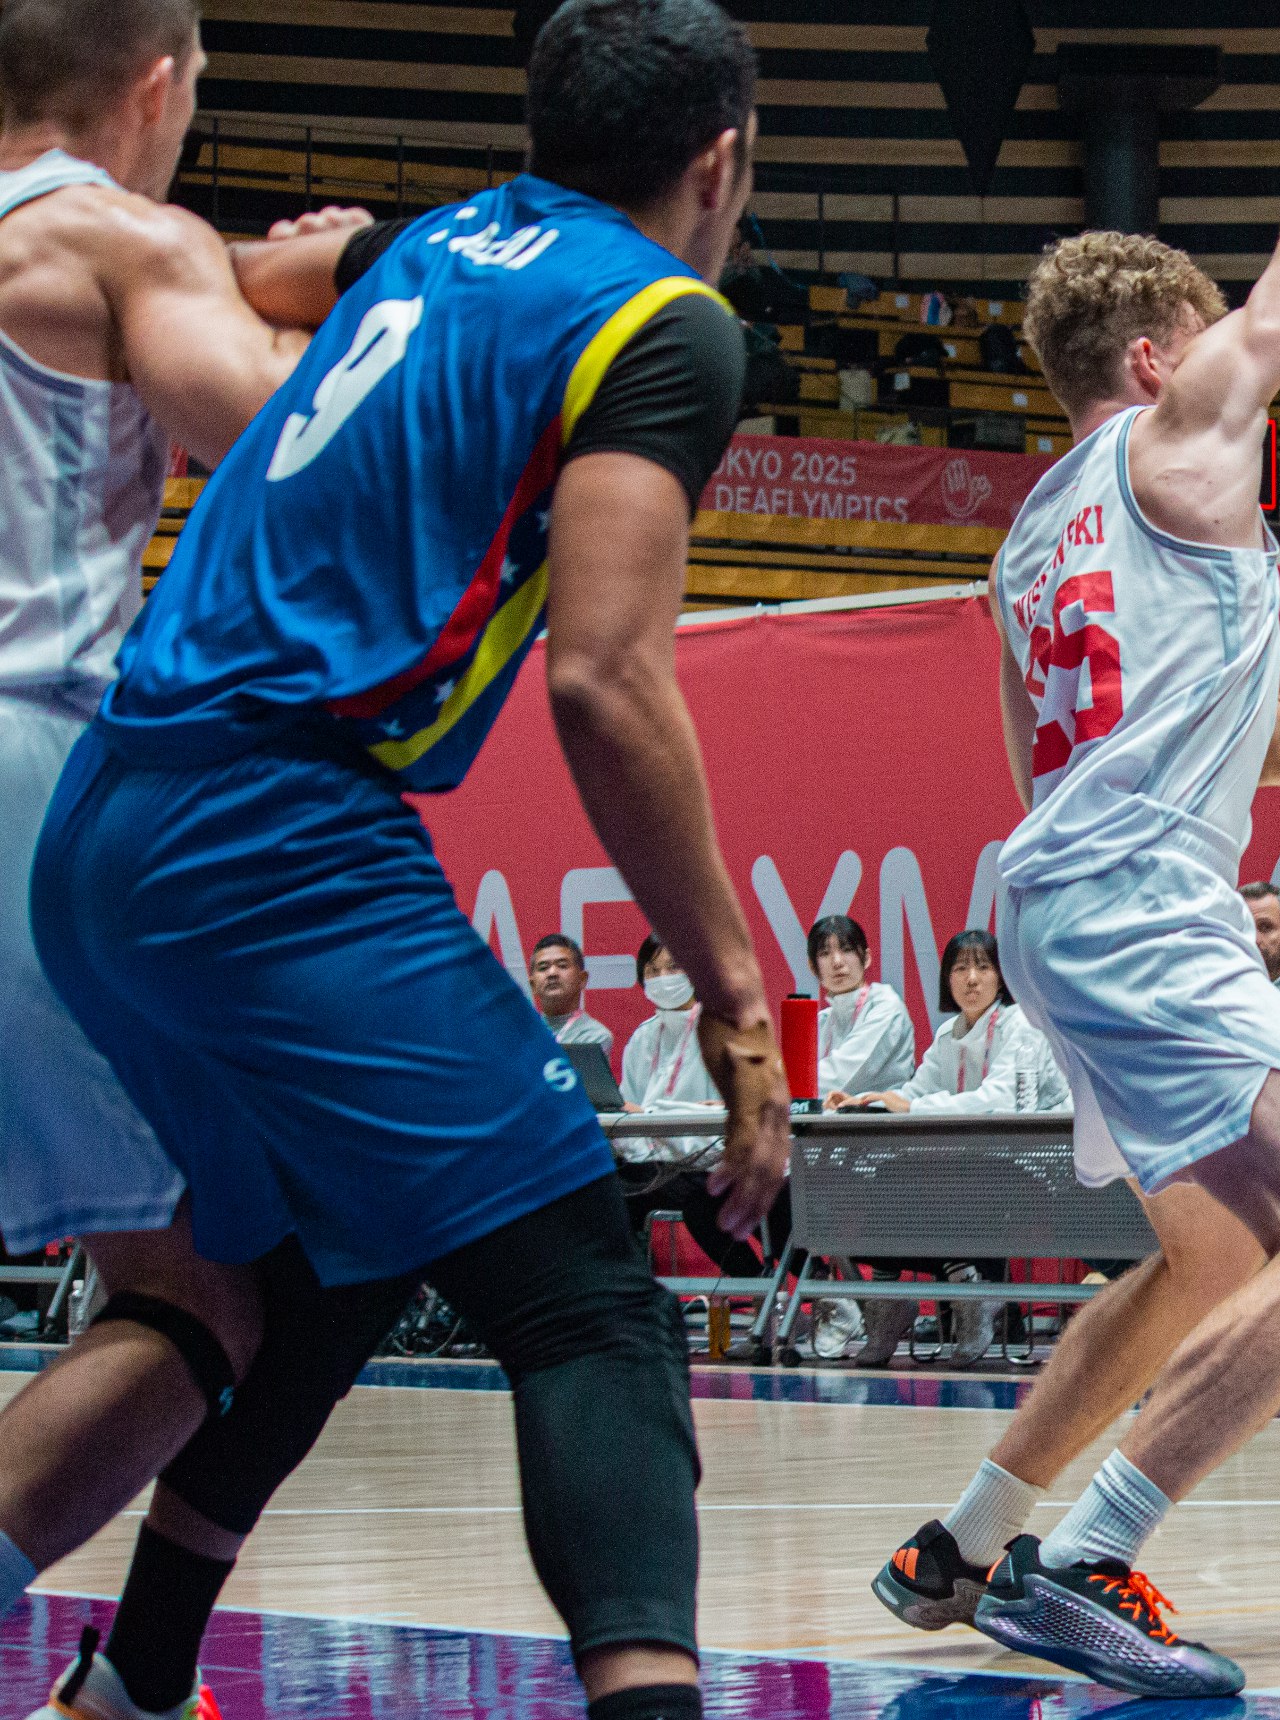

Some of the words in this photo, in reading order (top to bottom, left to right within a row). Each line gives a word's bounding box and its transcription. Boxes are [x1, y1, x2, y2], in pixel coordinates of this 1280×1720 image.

[265, 295, 424, 481] 9
[790, 450, 857, 485] 2025
[714, 484, 909, 525] DEAFLYMPICS
